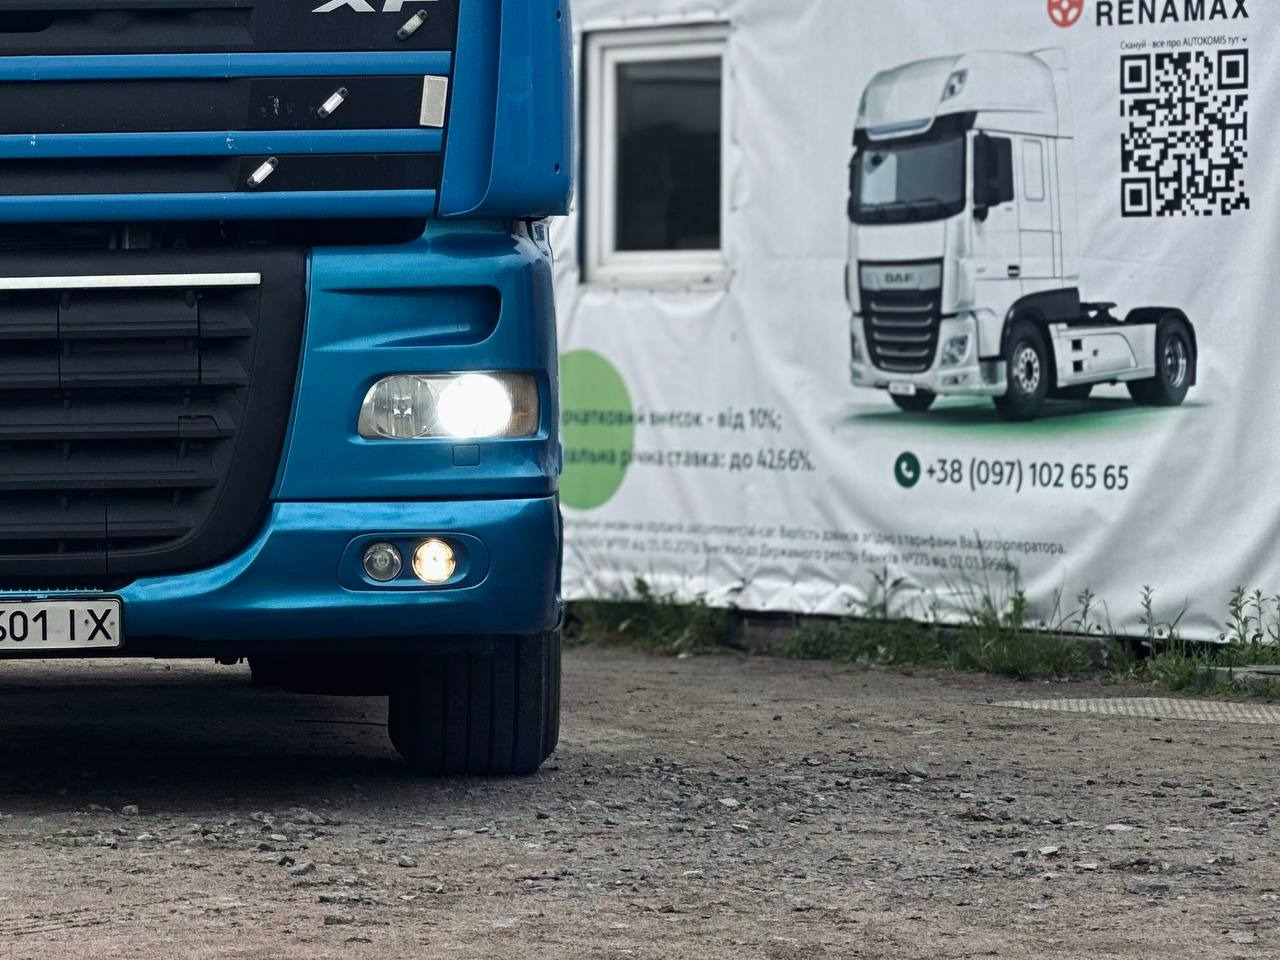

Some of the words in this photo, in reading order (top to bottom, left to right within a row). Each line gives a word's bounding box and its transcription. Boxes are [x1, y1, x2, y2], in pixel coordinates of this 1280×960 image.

[1152, 40, 1165, 49] все
[1166, 40, 1181, 49] про
[1183, 36, 1227, 47] AUTOKOMIS
[884, 272, 914, 284] DAF
[718, 407, 745, 431] від
[729, 451, 753, 472] до
[927, 459, 963, 484] +38
[970, 457, 1023, 493] (097)
[1030, 462, 1064, 488] 102
[1071, 464, 1097, 489] 65
[1104, 464, 1129, 490] 65
[69, 608, 113, 641] IX
